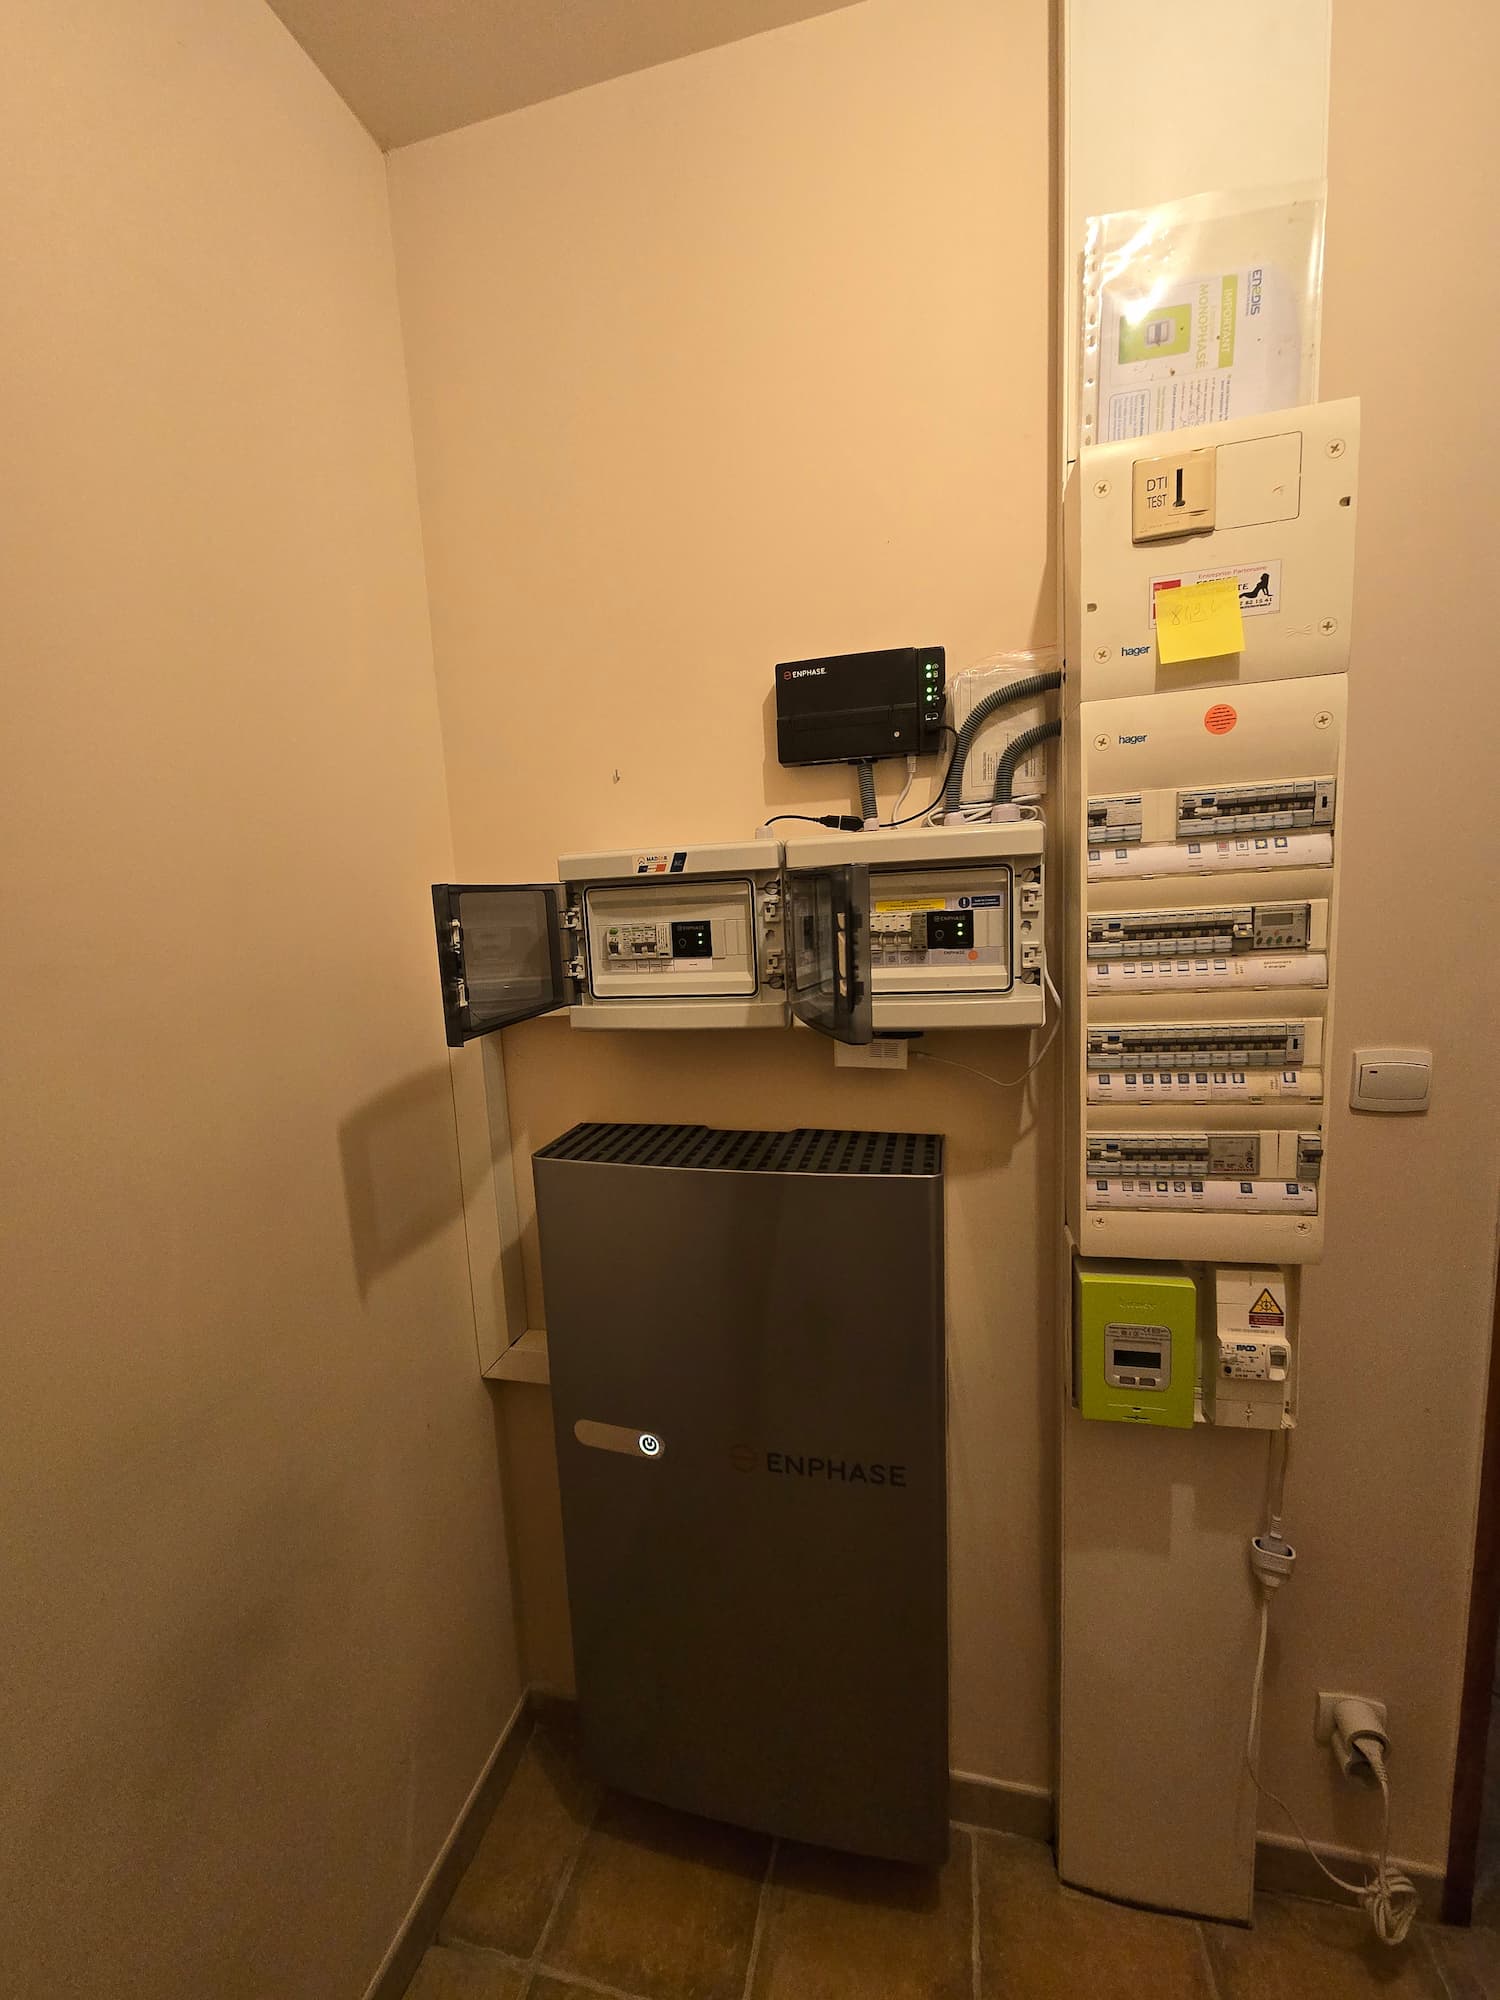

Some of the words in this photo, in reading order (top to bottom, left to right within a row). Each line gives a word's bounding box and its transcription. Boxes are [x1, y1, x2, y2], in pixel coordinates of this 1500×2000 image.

[1195, 284, 1209, 369] MONOPHASÉ
[1221, 288, 1233, 352] IMPORTANT
[1146, 476, 1168, 491] DTI
[1147, 494, 1167, 509] TEST
[1121, 645, 1151, 657] hager
[792, 667, 827, 679] ENPHASE
[1118, 734, 1148, 745] hager
[766, 1452, 907, 1488] ENPHASE
